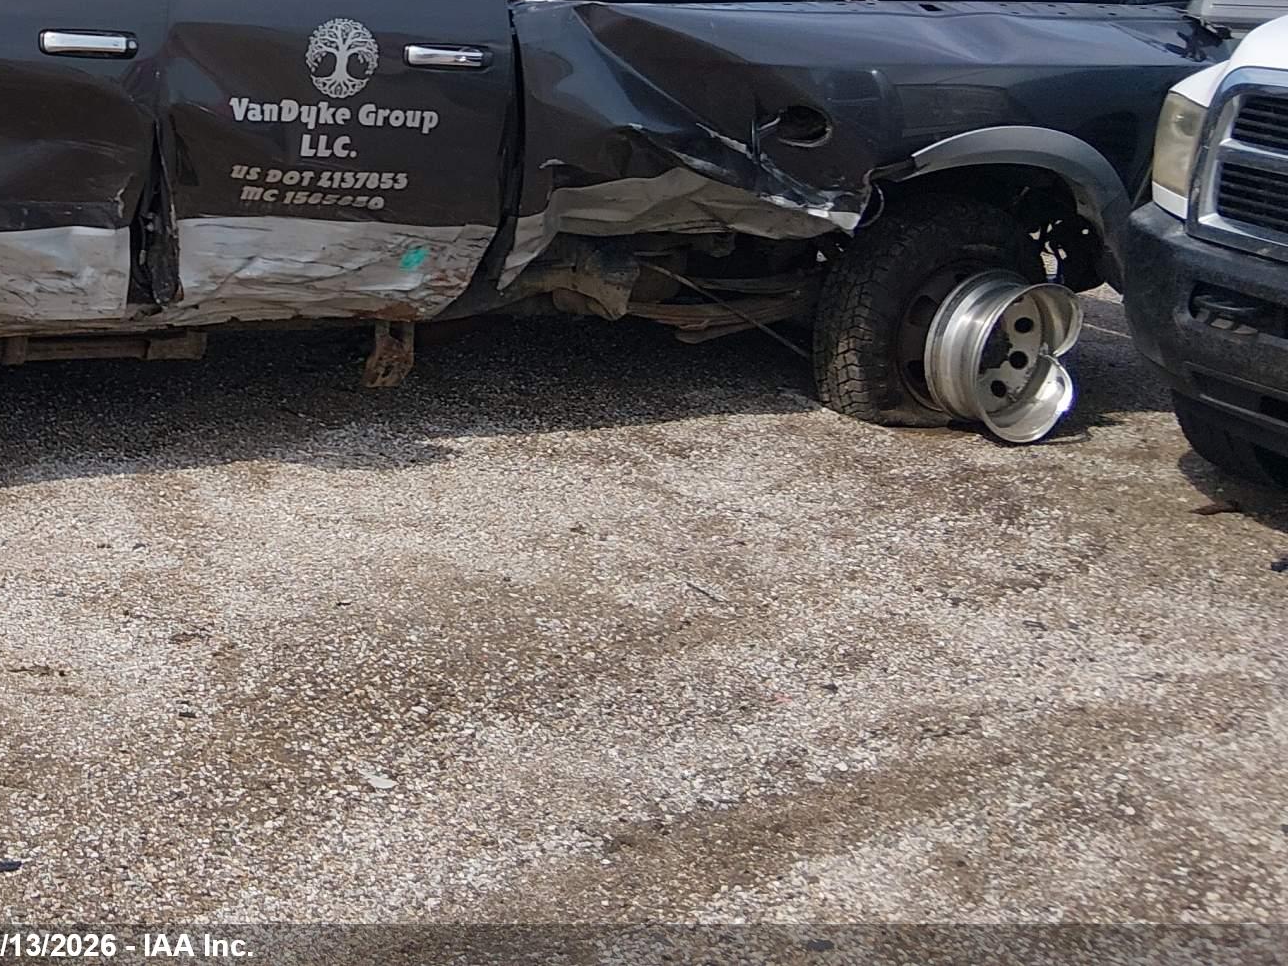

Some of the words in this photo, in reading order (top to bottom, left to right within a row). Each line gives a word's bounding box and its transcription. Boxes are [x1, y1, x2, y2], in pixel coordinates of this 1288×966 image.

[229, 97, 352, 130] VanDyke
[358, 104, 440, 134] Group
[300, 134, 358, 158] LLC.
[230, 164, 261, 181] US
[266, 168, 316, 188] DOT
[240, 186, 279, 203] MC
